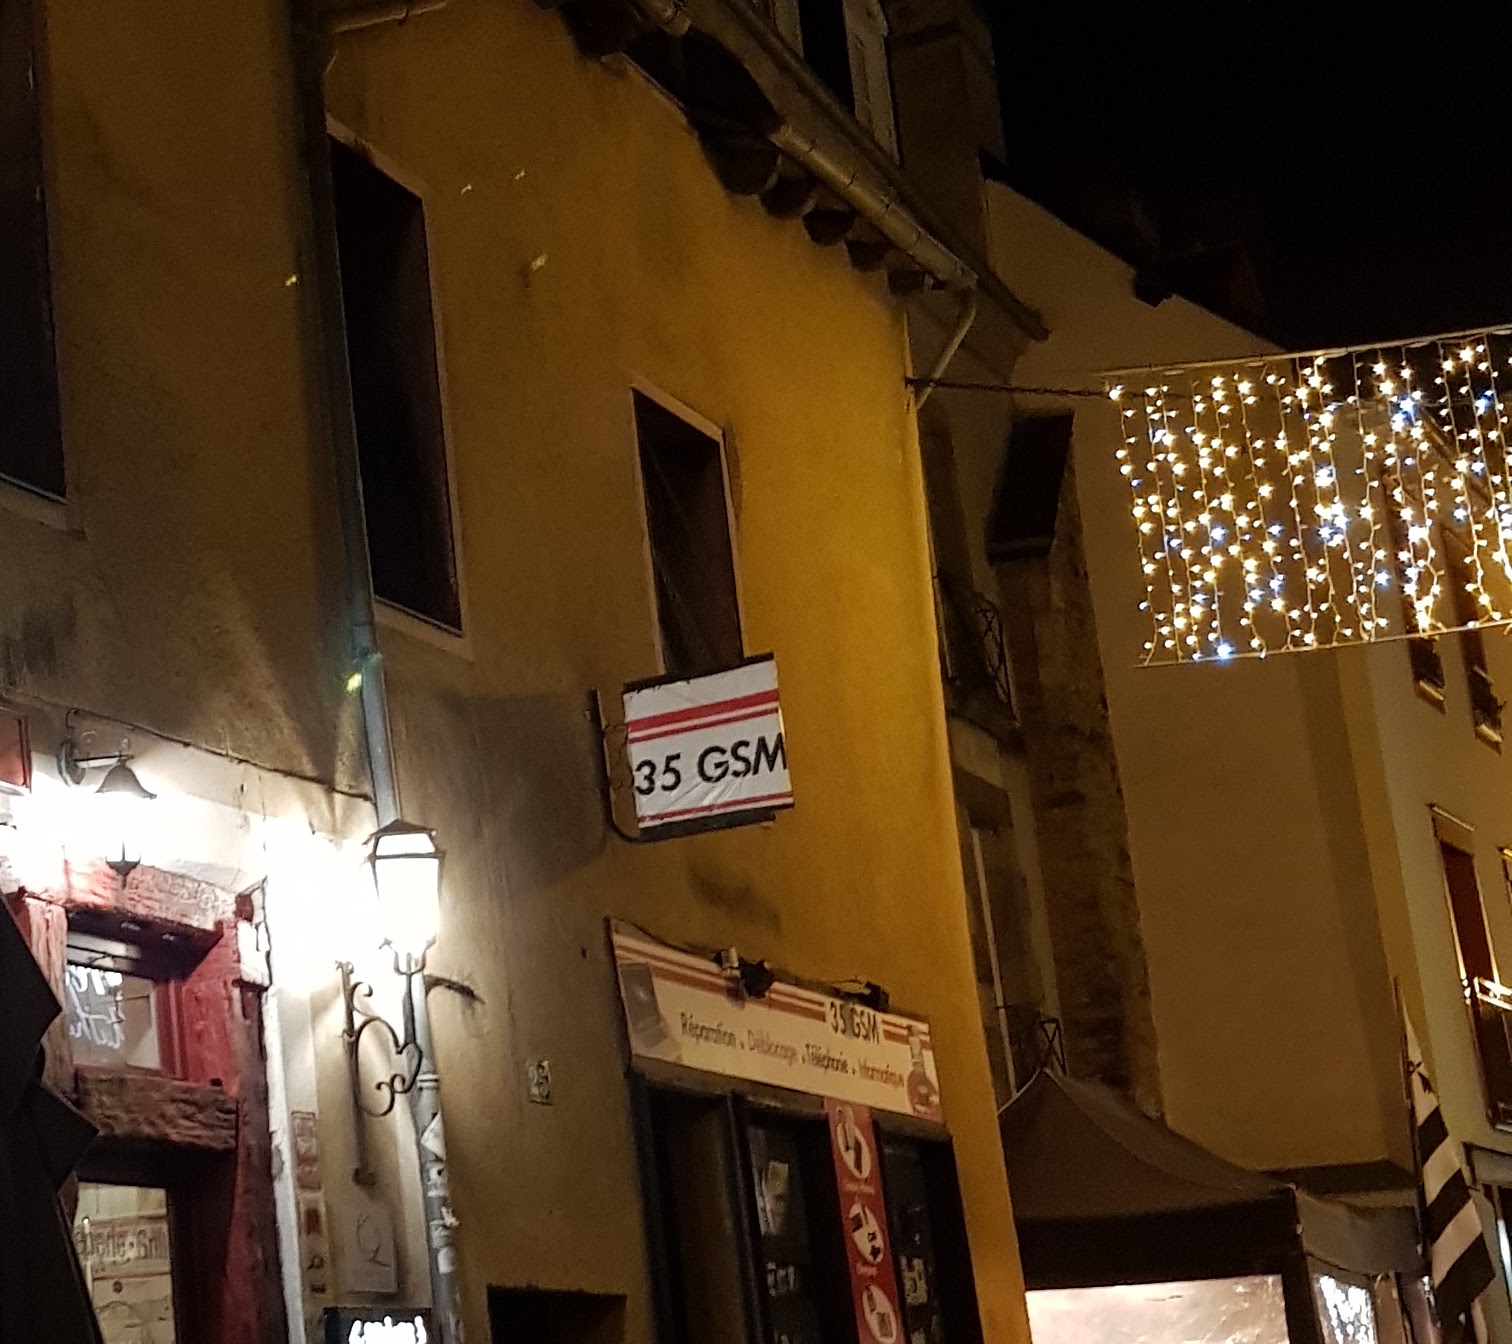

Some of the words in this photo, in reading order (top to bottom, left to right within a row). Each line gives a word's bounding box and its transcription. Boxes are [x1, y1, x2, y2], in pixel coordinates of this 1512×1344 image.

[634, 752, 682, 796] 35
[697, 731, 788, 784] GSM
[829, 1000, 847, 1036] 35
[849, 1006, 881, 1046] GSM
